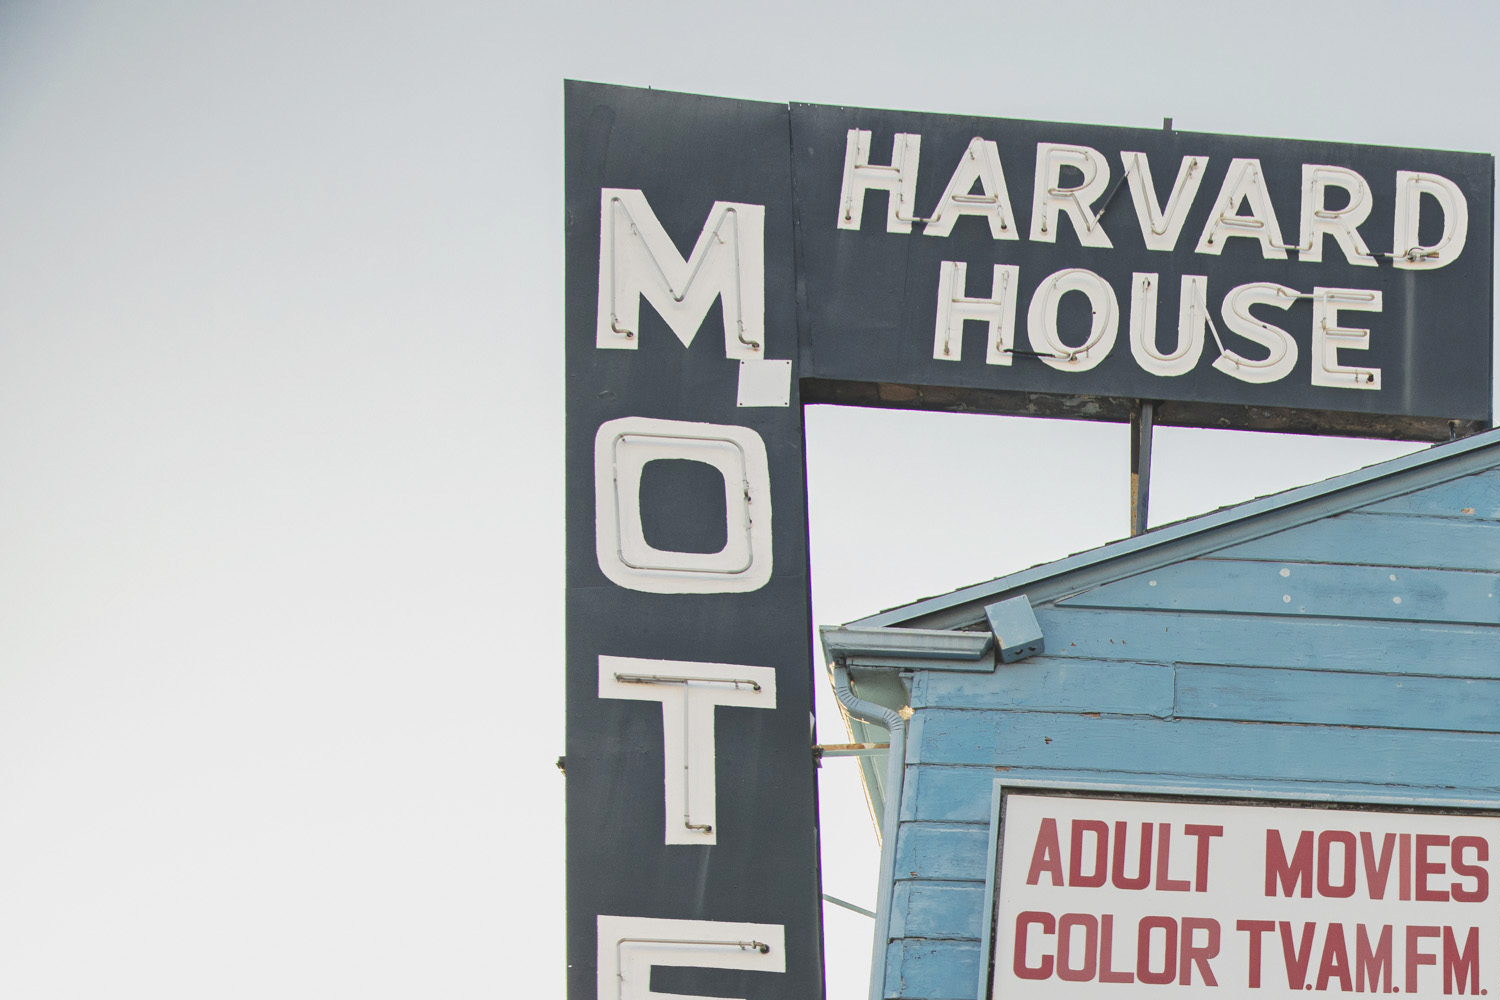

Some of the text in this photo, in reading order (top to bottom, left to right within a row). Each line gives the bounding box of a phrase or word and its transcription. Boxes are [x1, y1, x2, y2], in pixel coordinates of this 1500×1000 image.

[838, 127, 1469, 271] HARVARD
[932, 260, 1383, 391] HOUSE
[1026, 817, 1489, 903] ADULT MOVIES
[1013, 911, 1221, 987] COLOR
